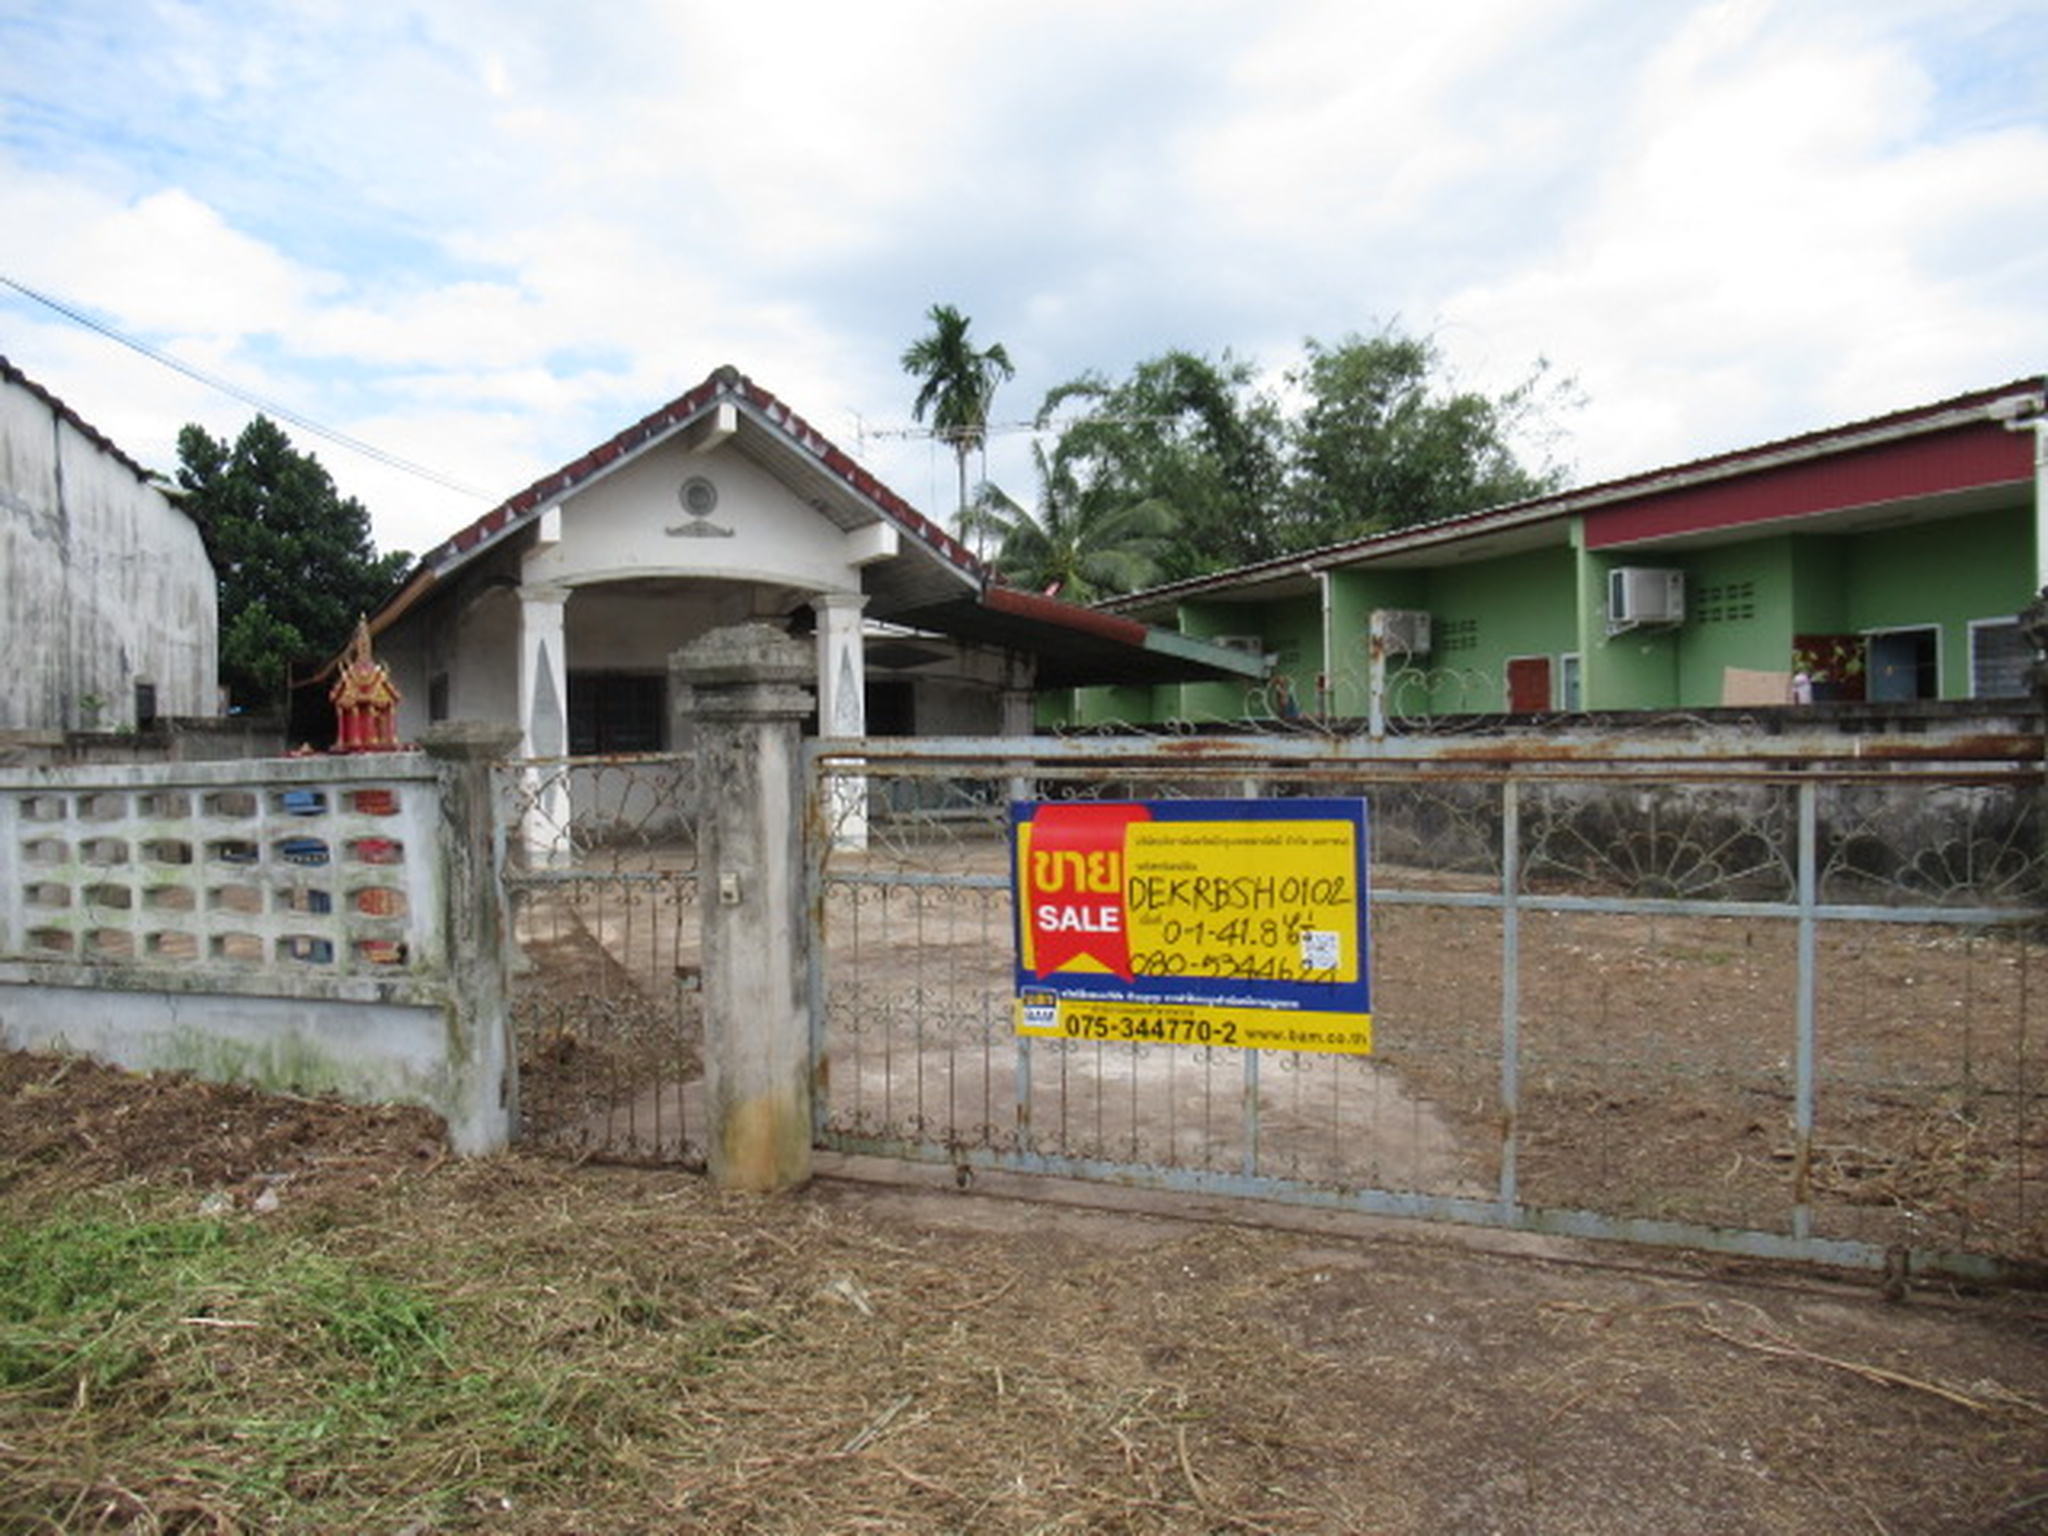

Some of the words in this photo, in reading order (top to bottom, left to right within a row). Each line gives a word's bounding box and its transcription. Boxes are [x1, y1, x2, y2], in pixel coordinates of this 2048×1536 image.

[1034, 851, 1121, 893] ขาย
[1038, 905, 1121, 933] SALE
[1065, 1014, 1237, 1044] 075-344770-2
